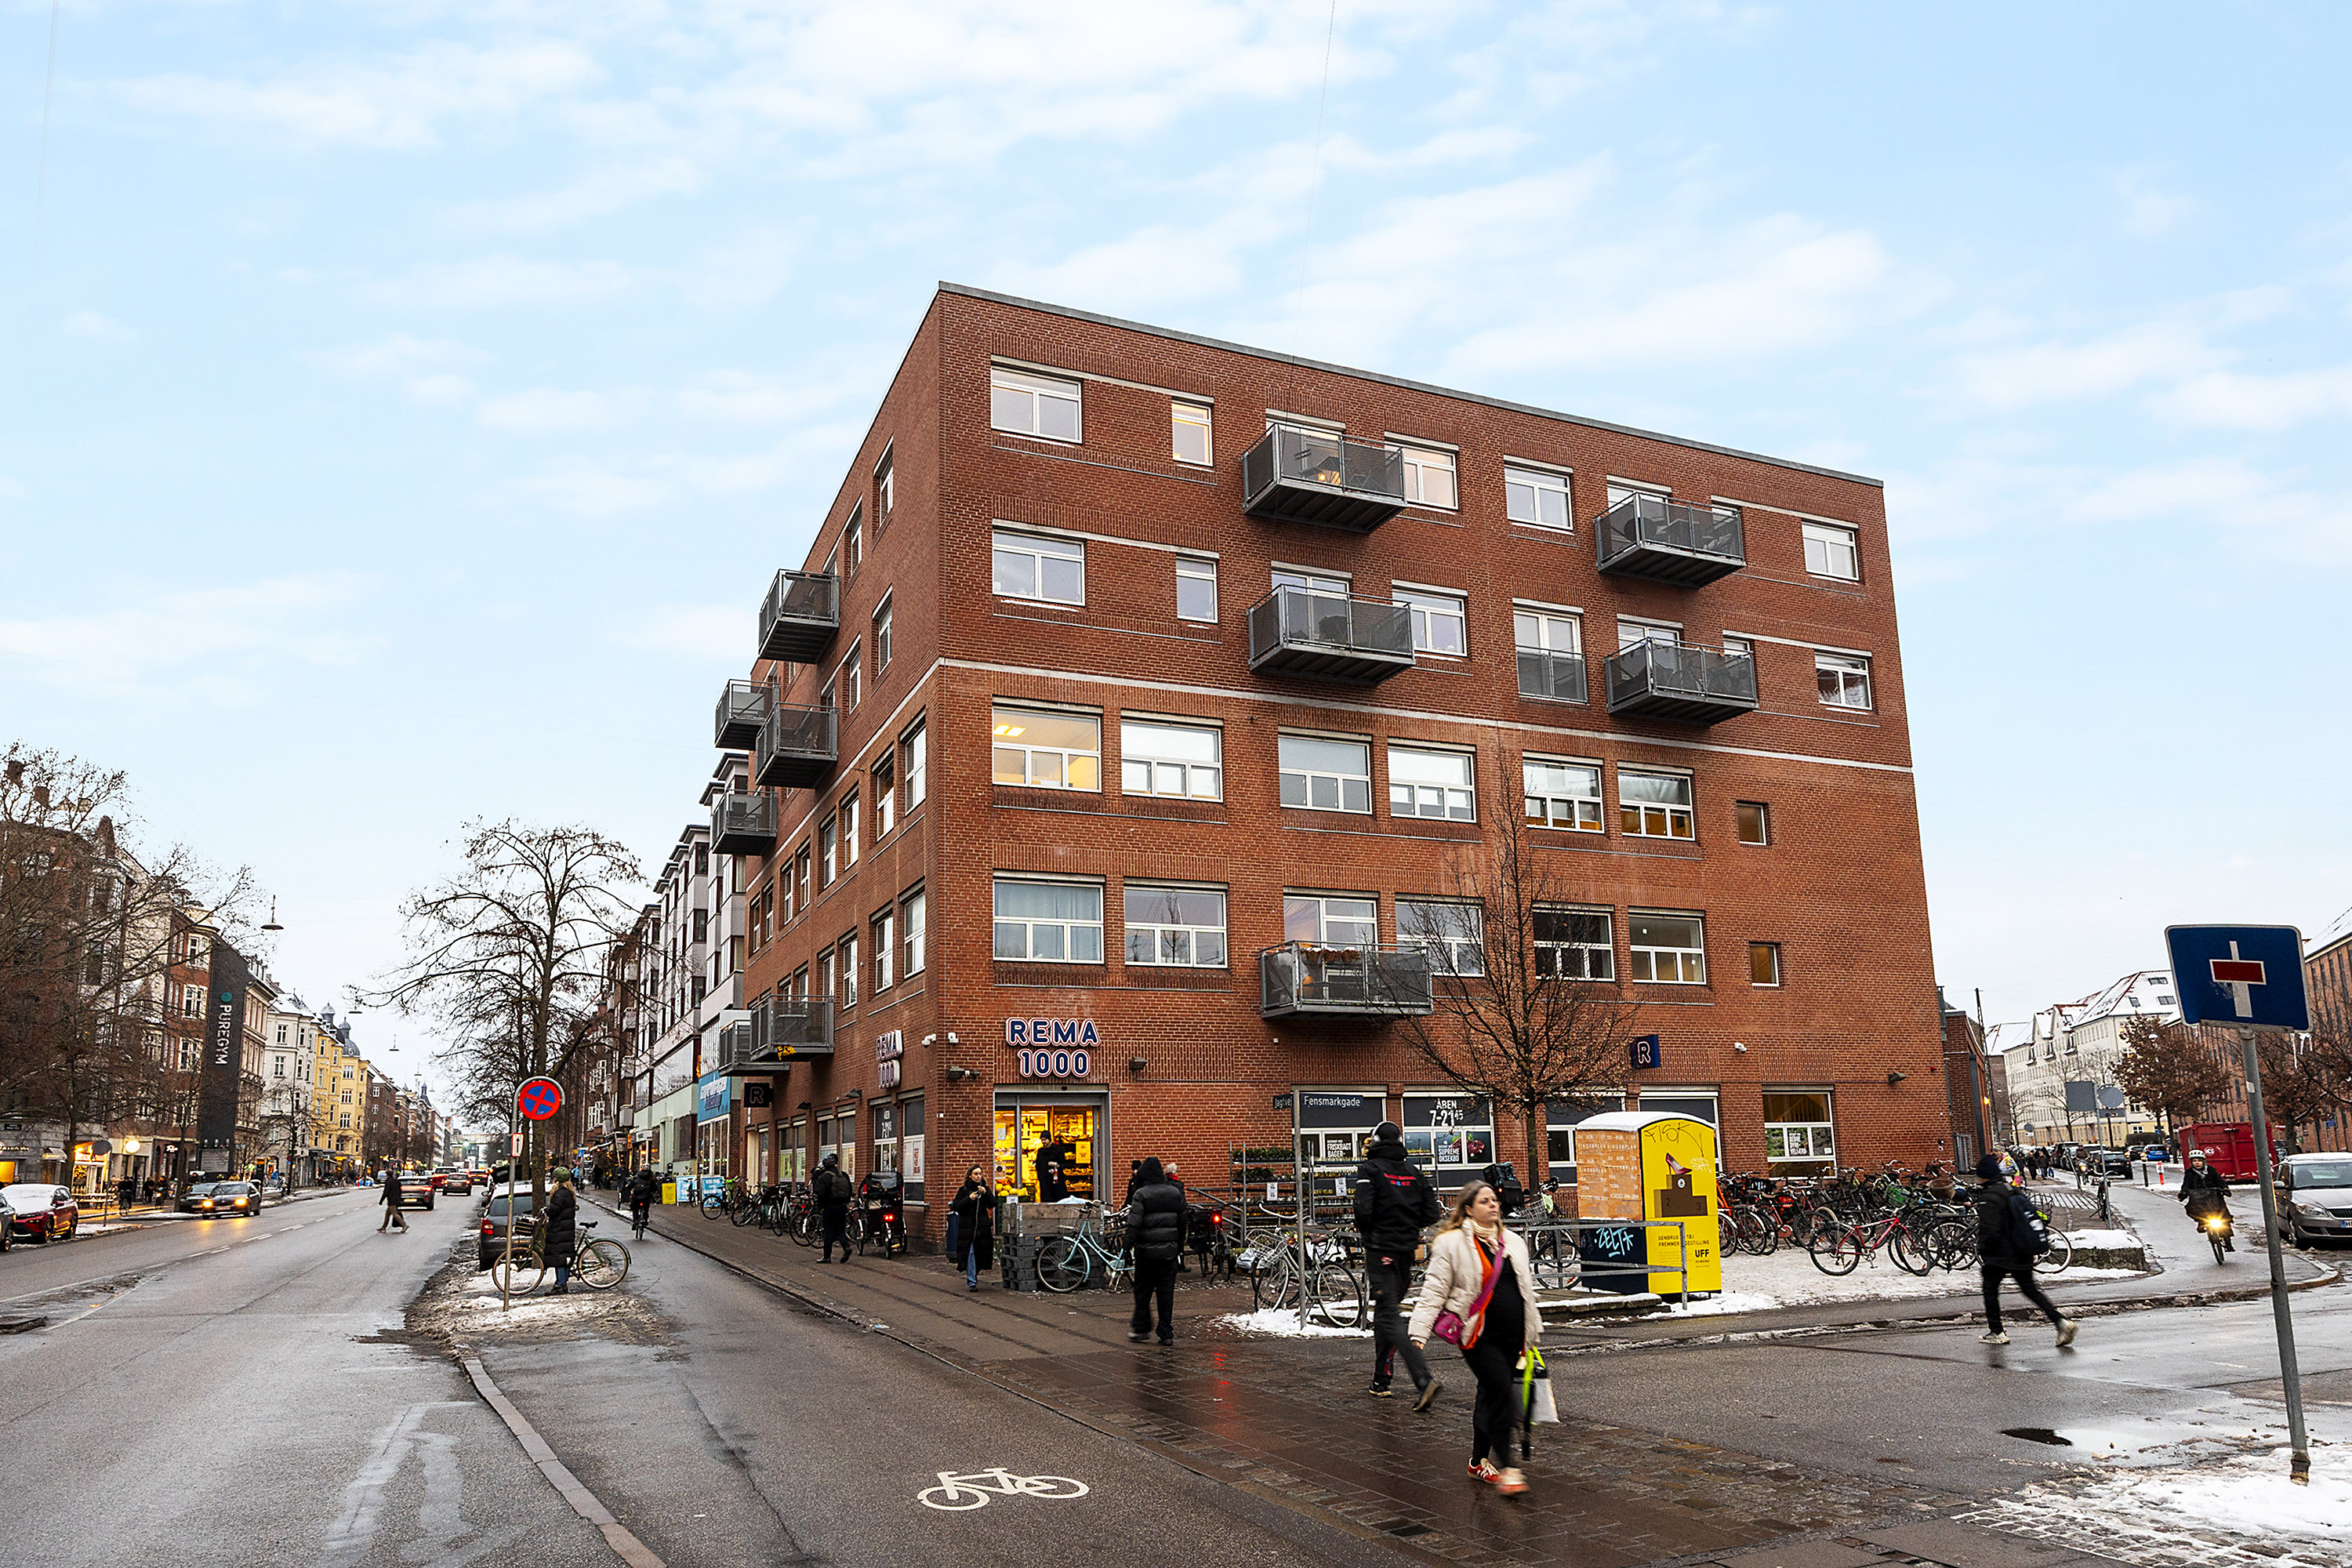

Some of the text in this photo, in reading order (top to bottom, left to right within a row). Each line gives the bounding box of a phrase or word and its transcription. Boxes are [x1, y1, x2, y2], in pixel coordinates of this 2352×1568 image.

[215, 1004, 232, 1064] PUREGYM
[1006, 1017, 1101, 1047] REMA
[1638, 1041, 1651, 1064] R
[1018, 1048, 1091, 1077] 1000
[750, 1086, 764, 1104] R
[1304, 1095, 1360, 1108] Fensmarkgade
[1327, 1142, 1352, 1151] FRISKBAGT
[1666, 1197, 1671, 1207] 2
[1697, 1202, 1702, 1212] 3
[1695, 1249, 1709, 1258] UFF
